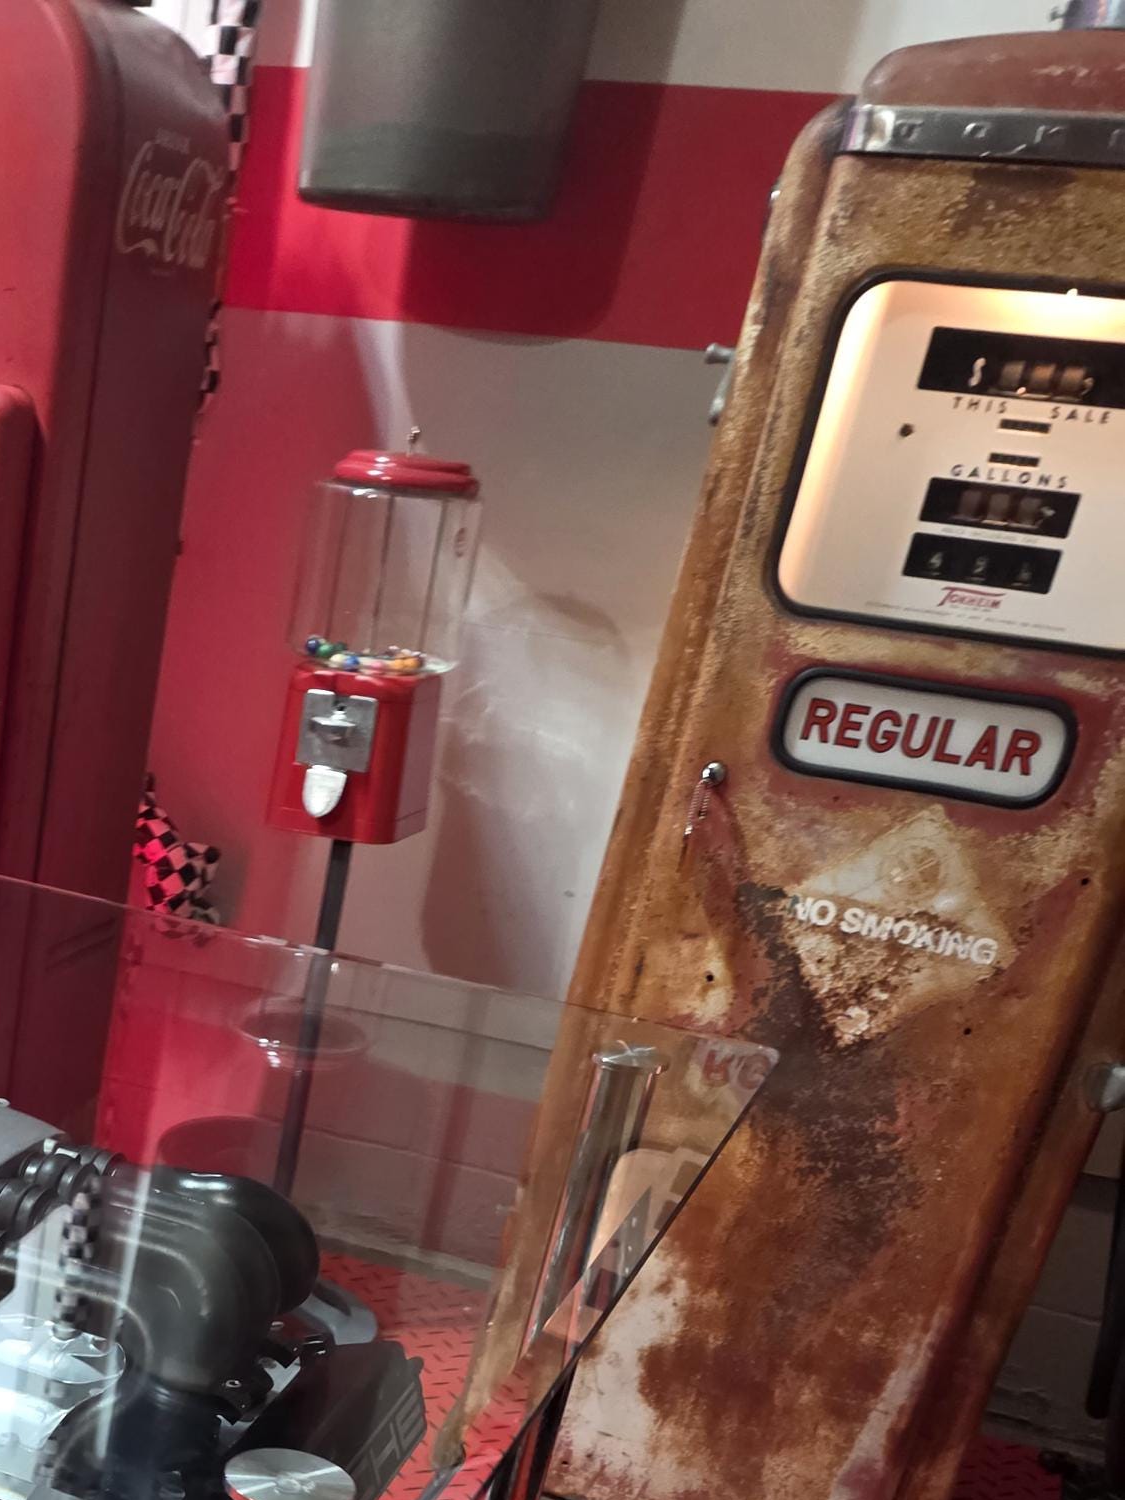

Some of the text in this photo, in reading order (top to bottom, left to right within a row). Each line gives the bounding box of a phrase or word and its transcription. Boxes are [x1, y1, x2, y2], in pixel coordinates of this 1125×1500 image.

[952, 396, 1111, 425] THIS SALE
[950, 464, 1068, 489] GALLONS
[799, 697, 1043, 776] REGULAR
[787, 894, 998, 965] NO SMOKING
